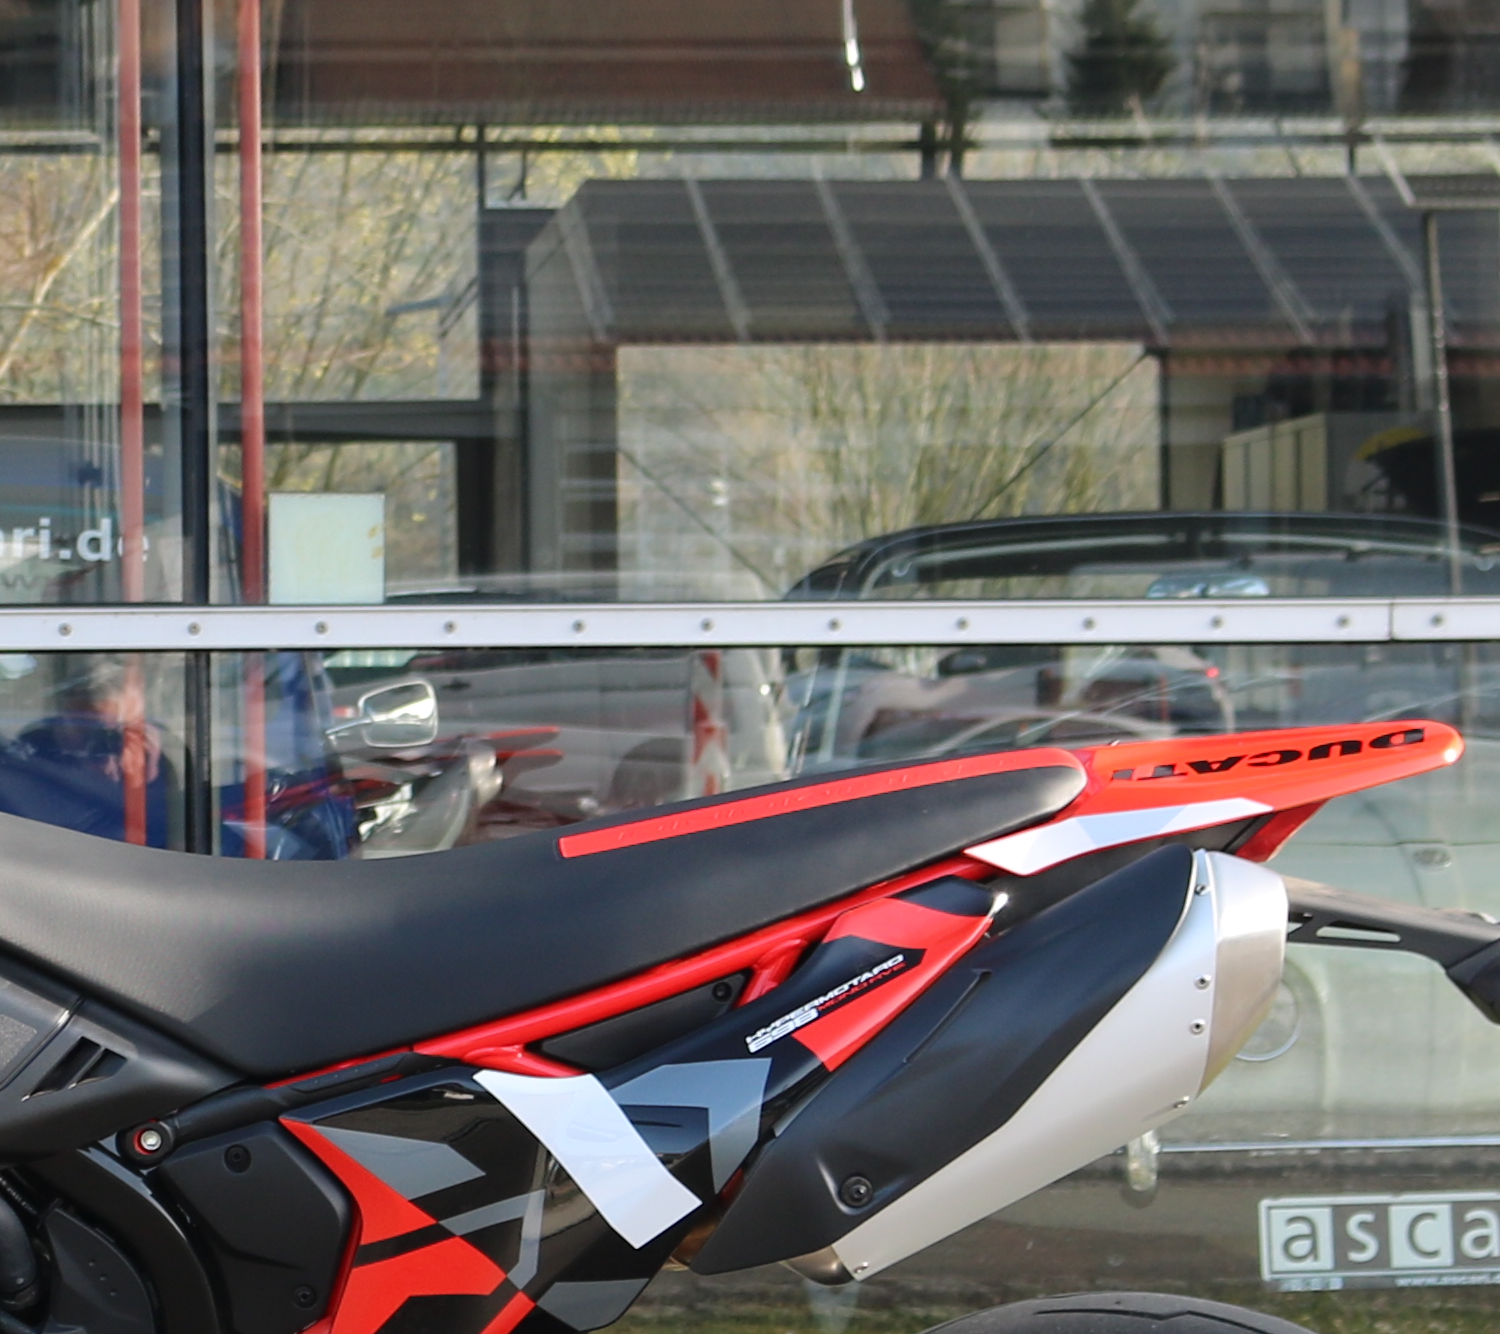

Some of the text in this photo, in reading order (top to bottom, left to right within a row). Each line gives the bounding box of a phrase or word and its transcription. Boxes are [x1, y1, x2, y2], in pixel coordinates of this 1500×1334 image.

[1108, 726, 1427, 781] DUCATI
[745, 953, 905, 1045] HYPERMOTARD
[748, 1008, 819, 1054] 698
